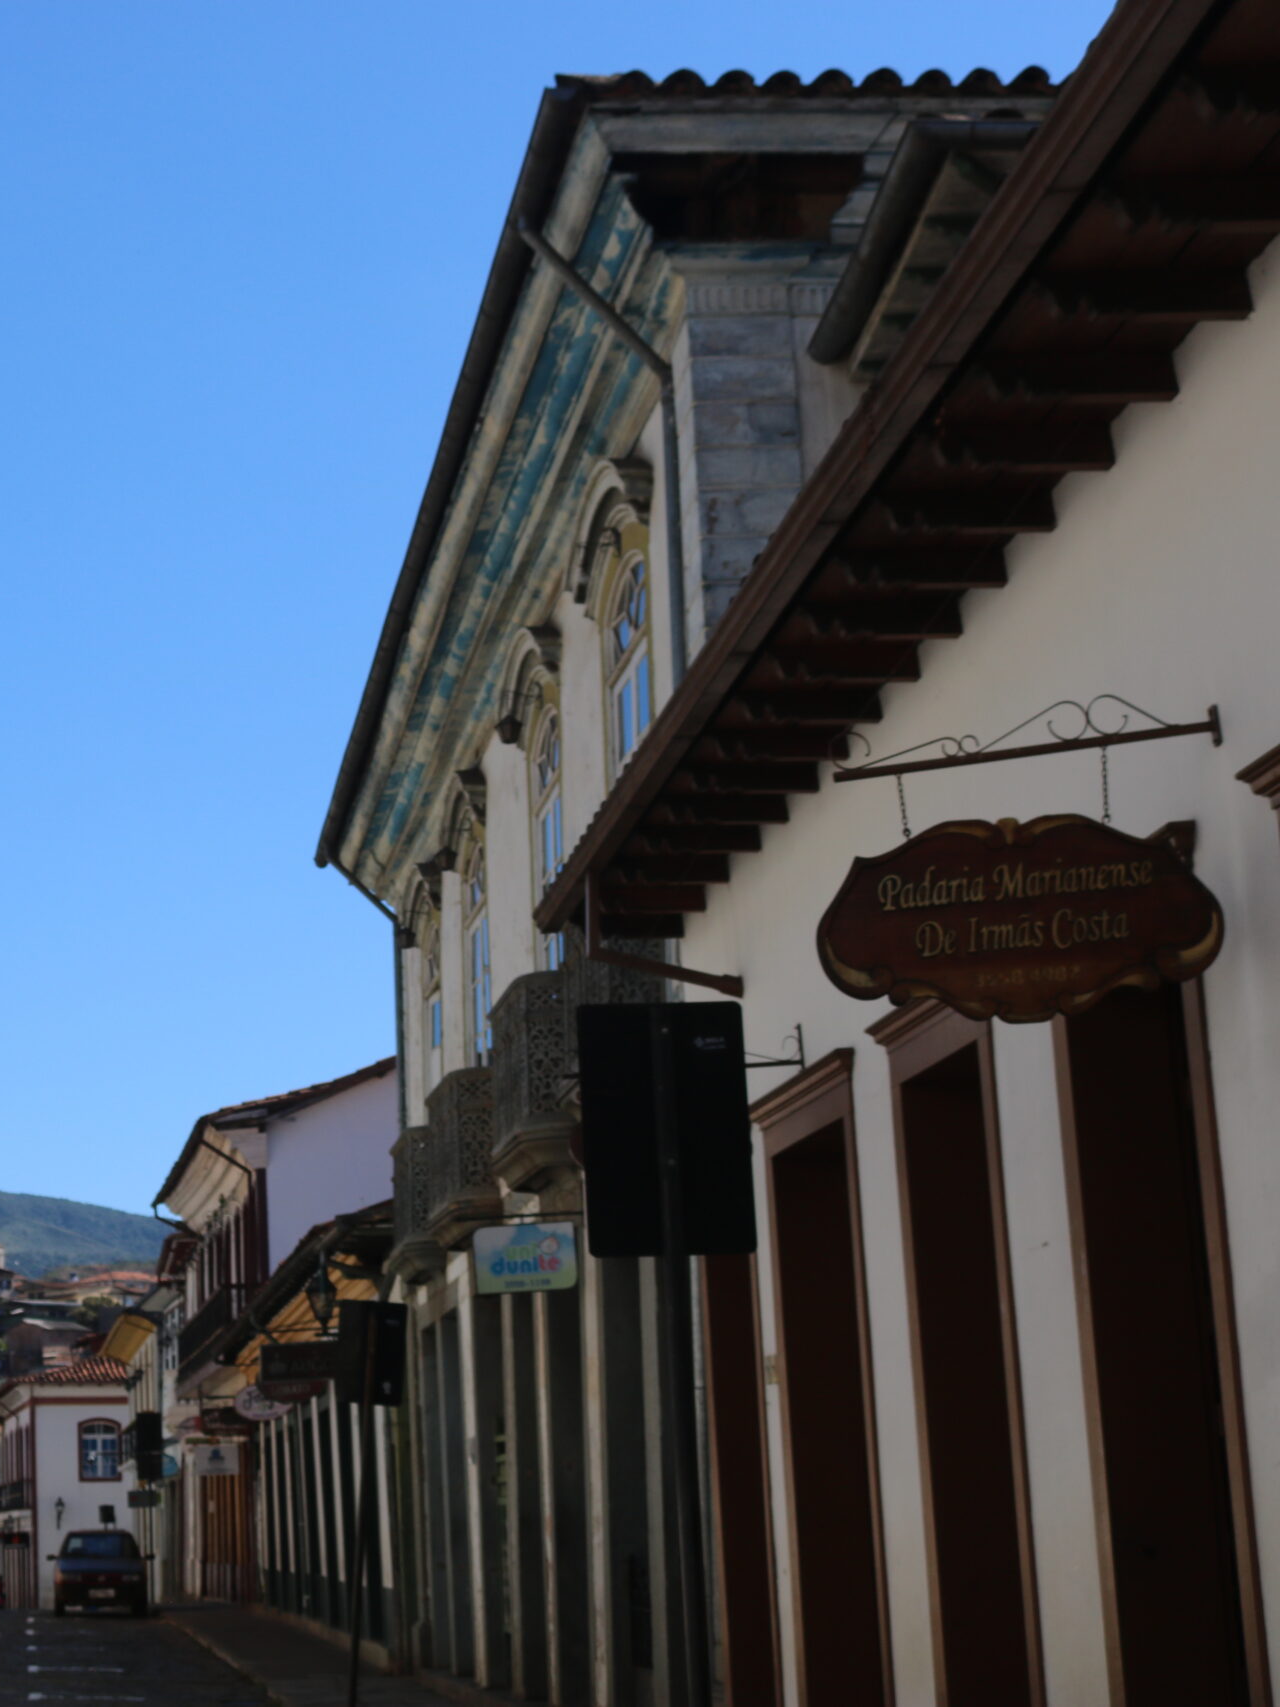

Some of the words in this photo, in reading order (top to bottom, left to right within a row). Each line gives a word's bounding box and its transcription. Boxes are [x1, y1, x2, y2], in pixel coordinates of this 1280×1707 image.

[877, 865, 986, 911] Padaria
[992, 857, 1153, 901] Marianense
[915, 920, 958, 957] De
[967, 913, 1045, 952] Irmãs
[1051, 907, 1130, 949] Costa
